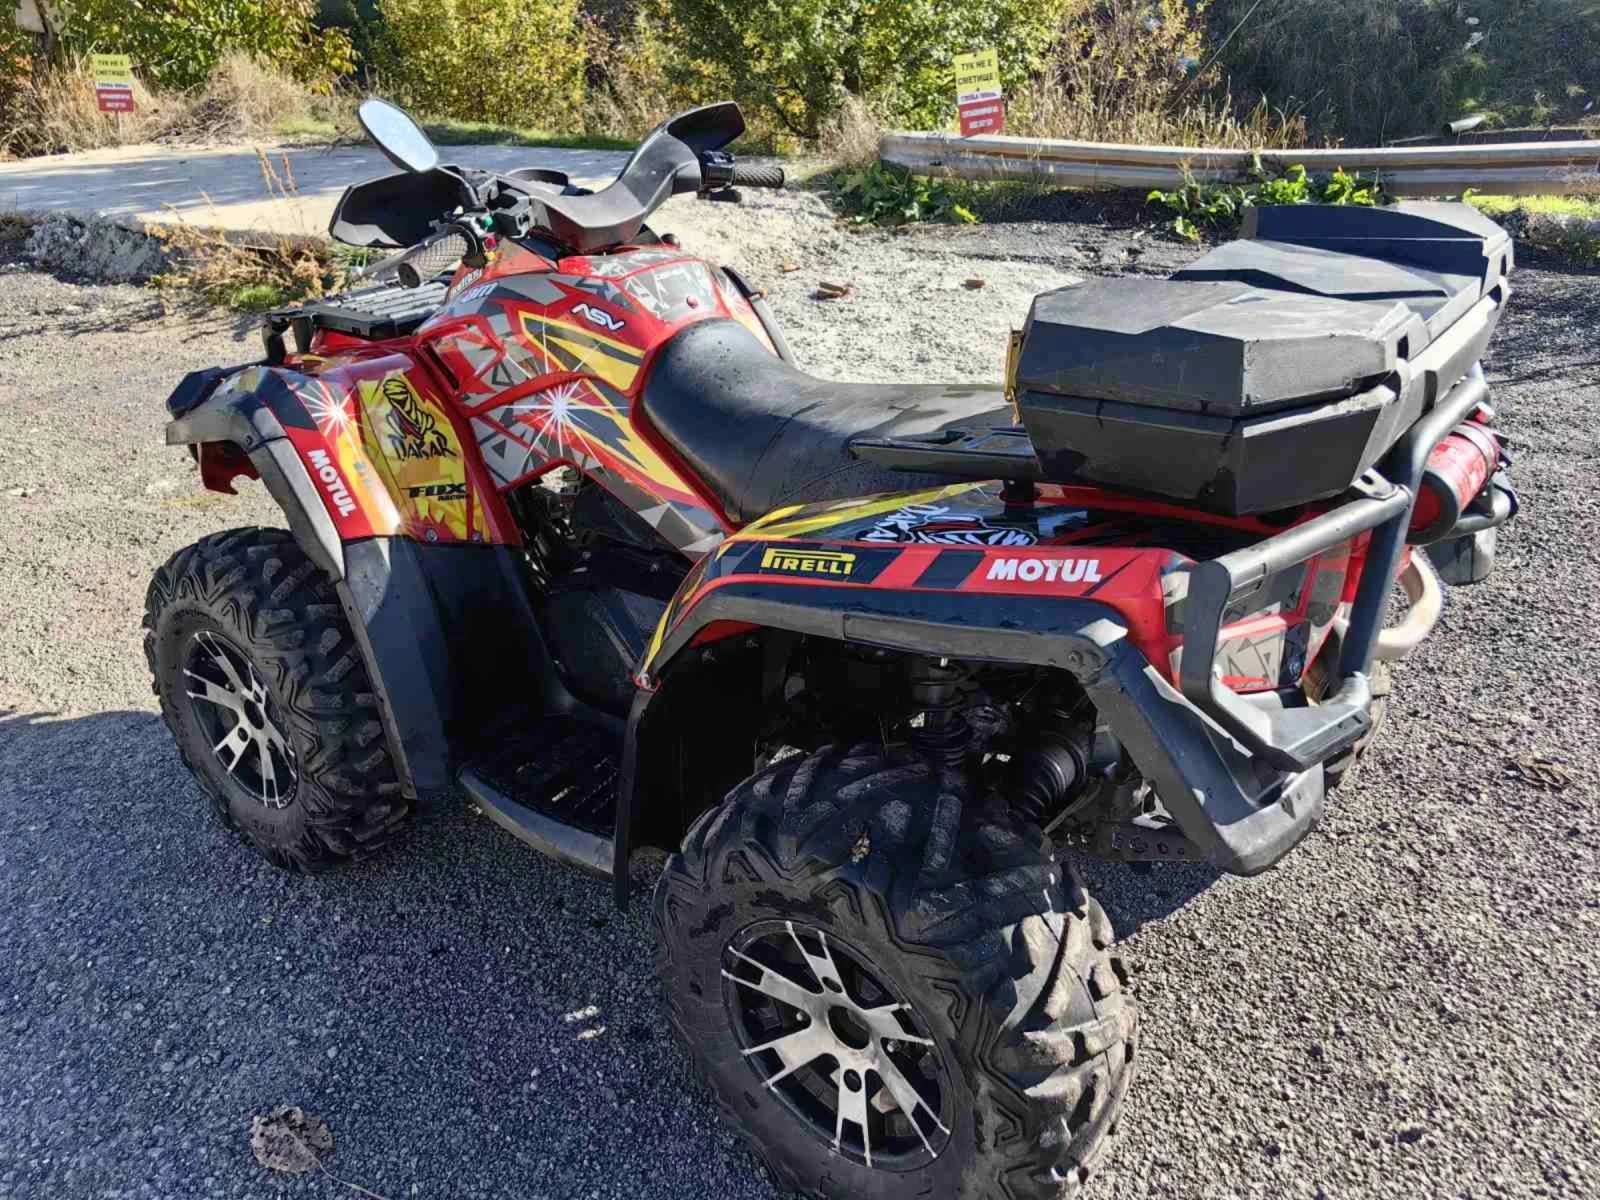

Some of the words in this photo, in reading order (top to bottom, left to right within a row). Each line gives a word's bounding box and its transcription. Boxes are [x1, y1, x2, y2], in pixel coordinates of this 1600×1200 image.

[387, 430, 457, 461] DAKAR
[307, 449, 357, 517] MOTUL
[409, 483, 466, 498] FOX
[760, 549, 856, 575] PIRELLI
[987, 558, 1102, 583] MOTUL
